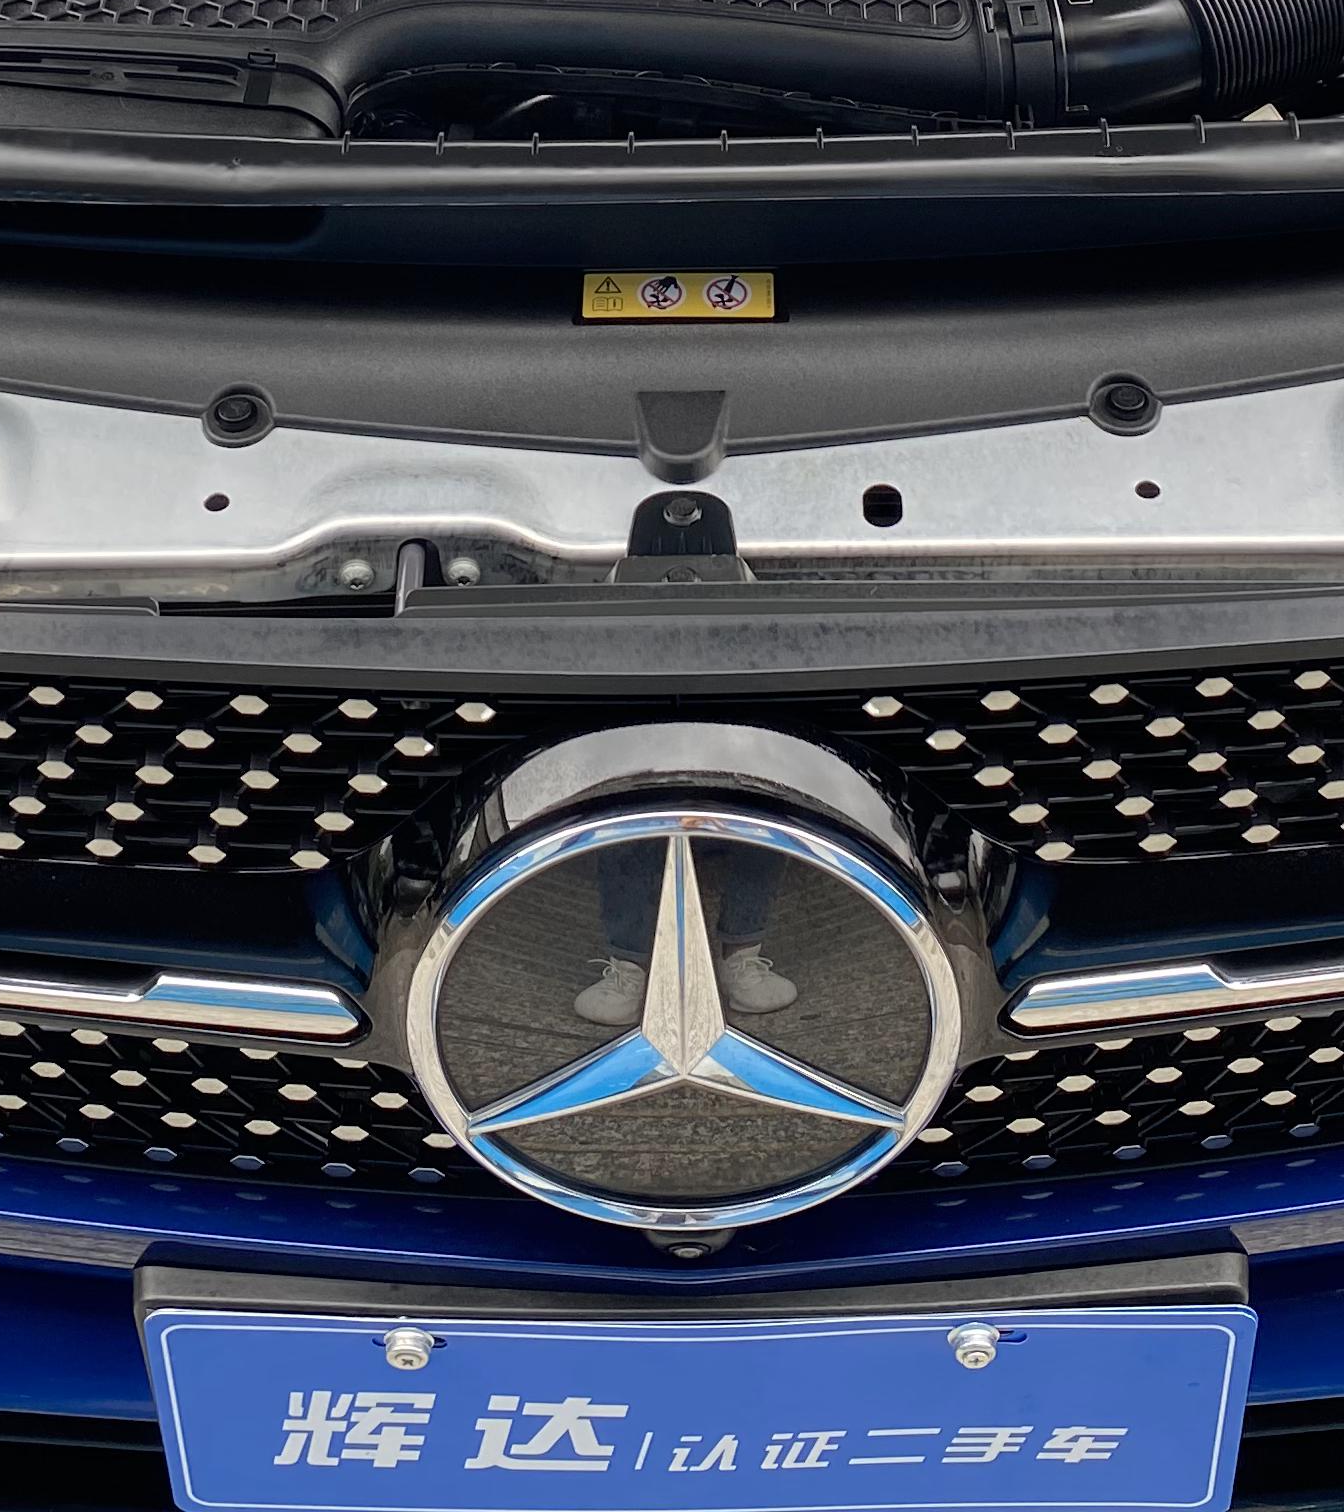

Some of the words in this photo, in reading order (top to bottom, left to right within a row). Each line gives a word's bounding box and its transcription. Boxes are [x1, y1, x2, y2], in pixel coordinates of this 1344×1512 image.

[274, 1391, 628, 1470] 辉达
[669, 1427, 1127, 1471] 认证二手车
